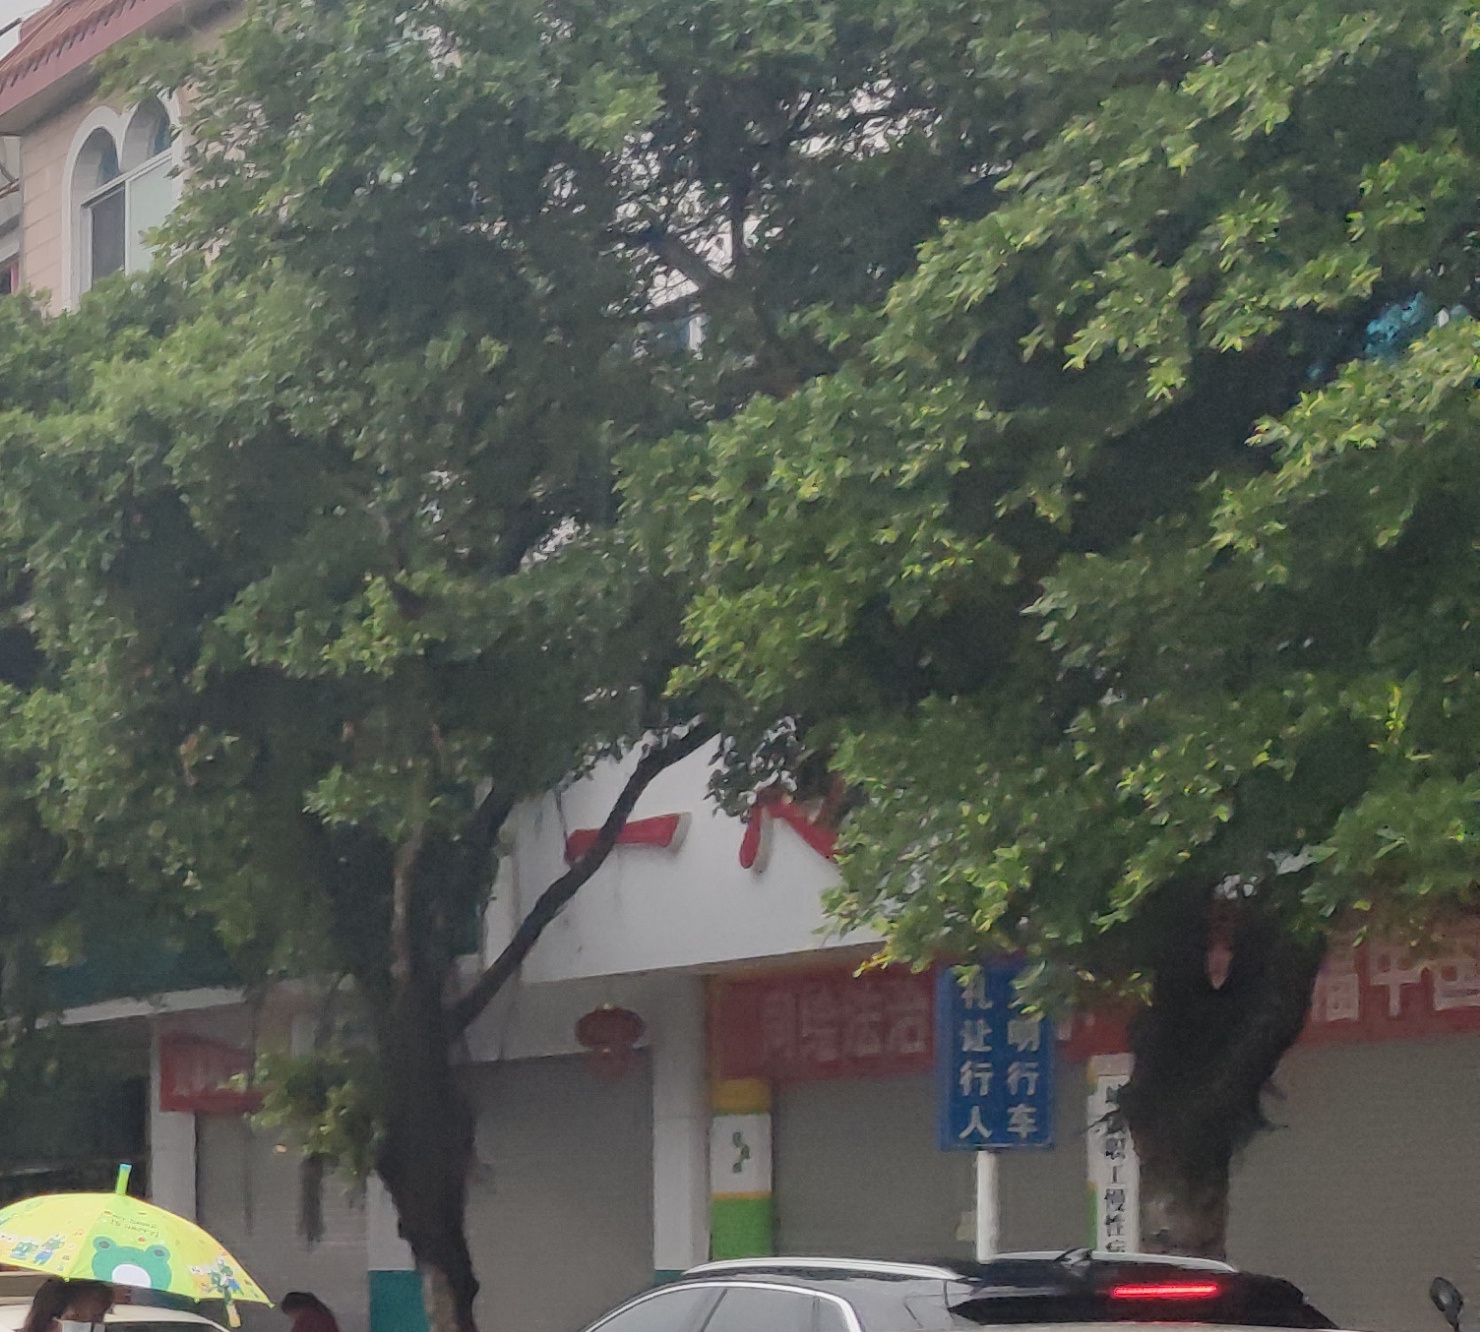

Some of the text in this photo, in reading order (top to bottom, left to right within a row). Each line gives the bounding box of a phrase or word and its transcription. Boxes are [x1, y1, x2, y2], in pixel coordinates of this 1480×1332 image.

[959, 967, 994, 1139] 礼让行人
[1007, 976, 1042, 1139] 明行车
